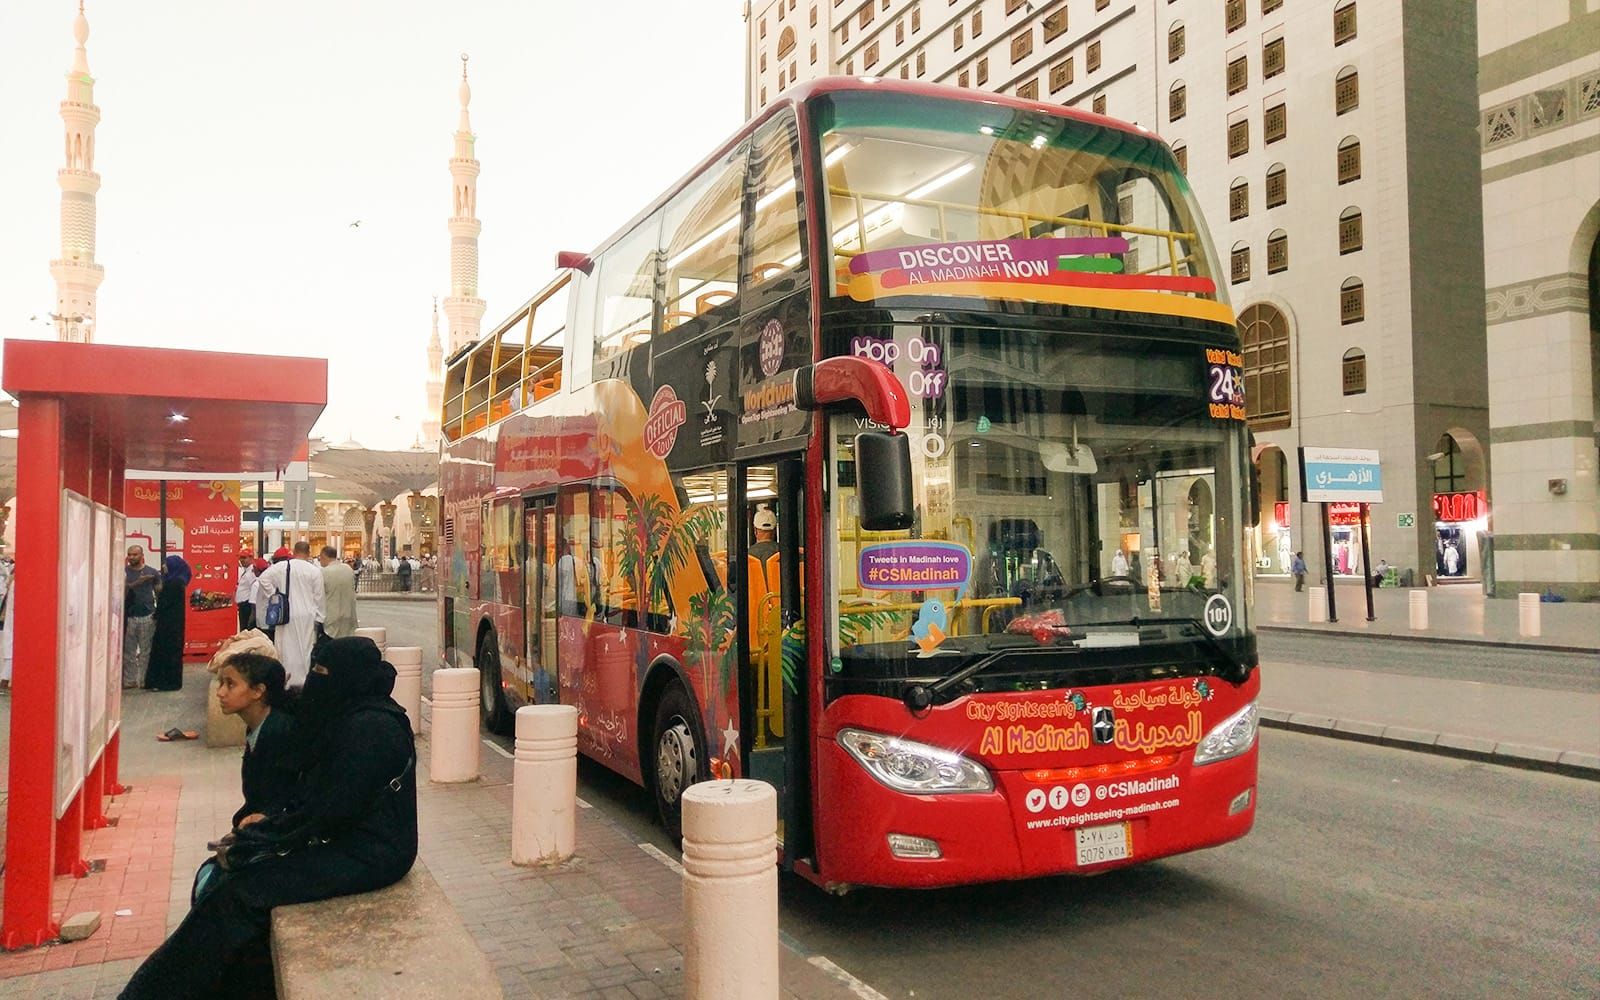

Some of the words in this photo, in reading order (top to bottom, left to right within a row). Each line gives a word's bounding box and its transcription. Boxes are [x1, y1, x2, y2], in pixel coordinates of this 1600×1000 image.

[899, 243, 1013, 270] DISCOVER
[908, 271, 929, 285] AL
[931, 265, 1001, 283] MADINAH
[1003, 259, 1049, 279] NOW
[854, 339, 900, 364] Hop
[907, 337, 938, 363] On
[744, 378, 795, 412] Worldwi
[909, 370, 942, 395] Off
[1210, 367, 1234, 401] 24
[646, 404, 684, 444] OFFICIAL
[1315, 467, 1373, 488] الأزهري
[869, 555, 898, 564] Tweets
[900, 555, 907, 563] in
[909, 555, 941, 563] Madinah
[943, 555, 959, 563] love
[868, 567, 959, 581] #CSMadinah
[1209, 607, 1228, 622] 101
[966, 700, 996, 721] City
[996, 699, 1076, 721] Sightseeing
[1113, 688, 1168, 712] سياحية
[1168, 686, 1203, 709] جولة
[980, 725, 1003, 755] Al
[1007, 721, 1089, 753] Madinah
[1114, 710, 1202, 754] المدينة
[1095, 774, 1180, 800] @CSMadinah
[1027, 799, 1180, 829] www.citysightseeing-madinah.com
[1081, 847, 1105, 863] 5078
